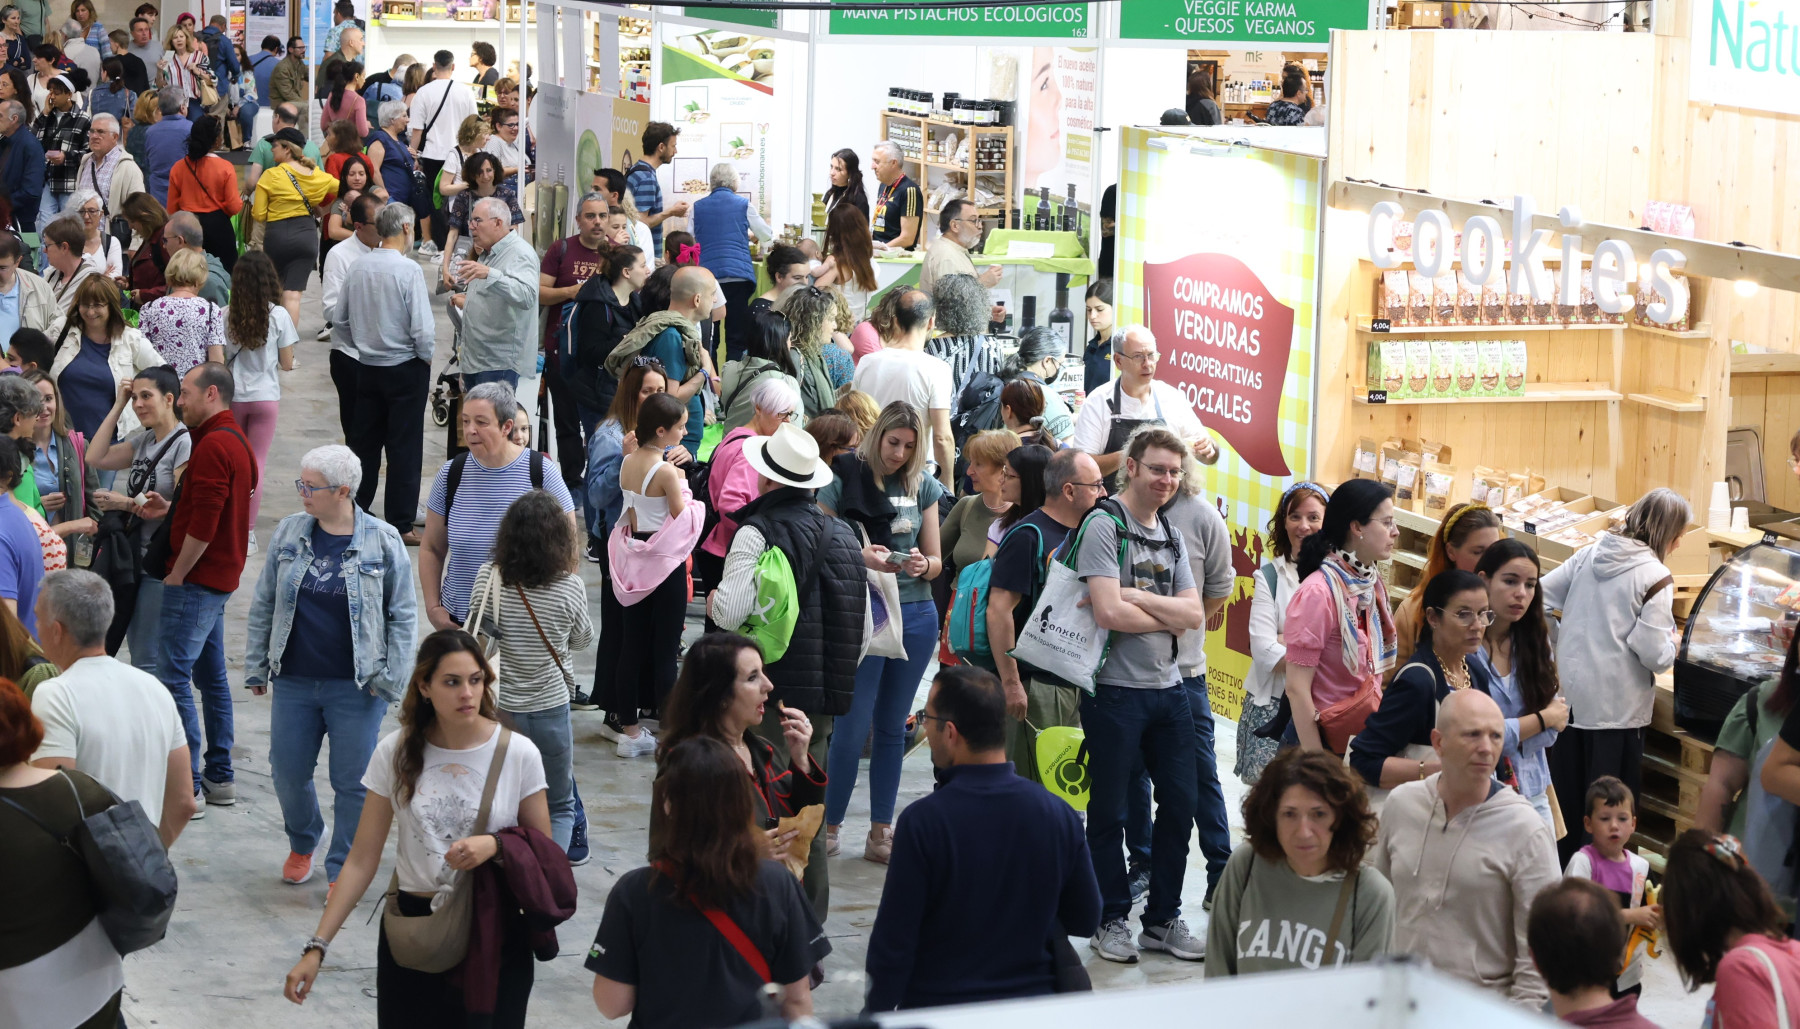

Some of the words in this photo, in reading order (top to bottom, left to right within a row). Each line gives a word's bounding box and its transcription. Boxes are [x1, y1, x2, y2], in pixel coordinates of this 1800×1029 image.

[894, 8, 979, 22] PISTACHOS
[1185, 0, 1240, 16] VEGGIE
[1245, 2, 1297, 18] KARMA
[1072, 27, 1087, 37] 162
[1175, 18, 1235, 35] QUESOS
[1244, 19, 1315, 36] VEGANOS
[1063, 59, 1078, 70] nuevo
[1079, 58, 1095, 73] aceite
[1062, 75, 1075, 90] 100%
[1076, 78, 1095, 92] natural
[1065, 98, 1077, 111] para
[1078, 96, 1083, 110] la
[1084, 97, 1094, 111] alta
[1368, 195, 1687, 324] cookies
[1173, 276, 1264, 320] COMPRAMOS
[1174, 308, 1261, 356] VERDURAS
[1169, 348, 1177, 366] A
[1180, 351, 1262, 390] COOPERATIVAS
[1177, 381, 1252, 424] SOCIALES
[1208, 666, 1243, 690] POSITIVO
[1228, 691, 1238, 706] EN
